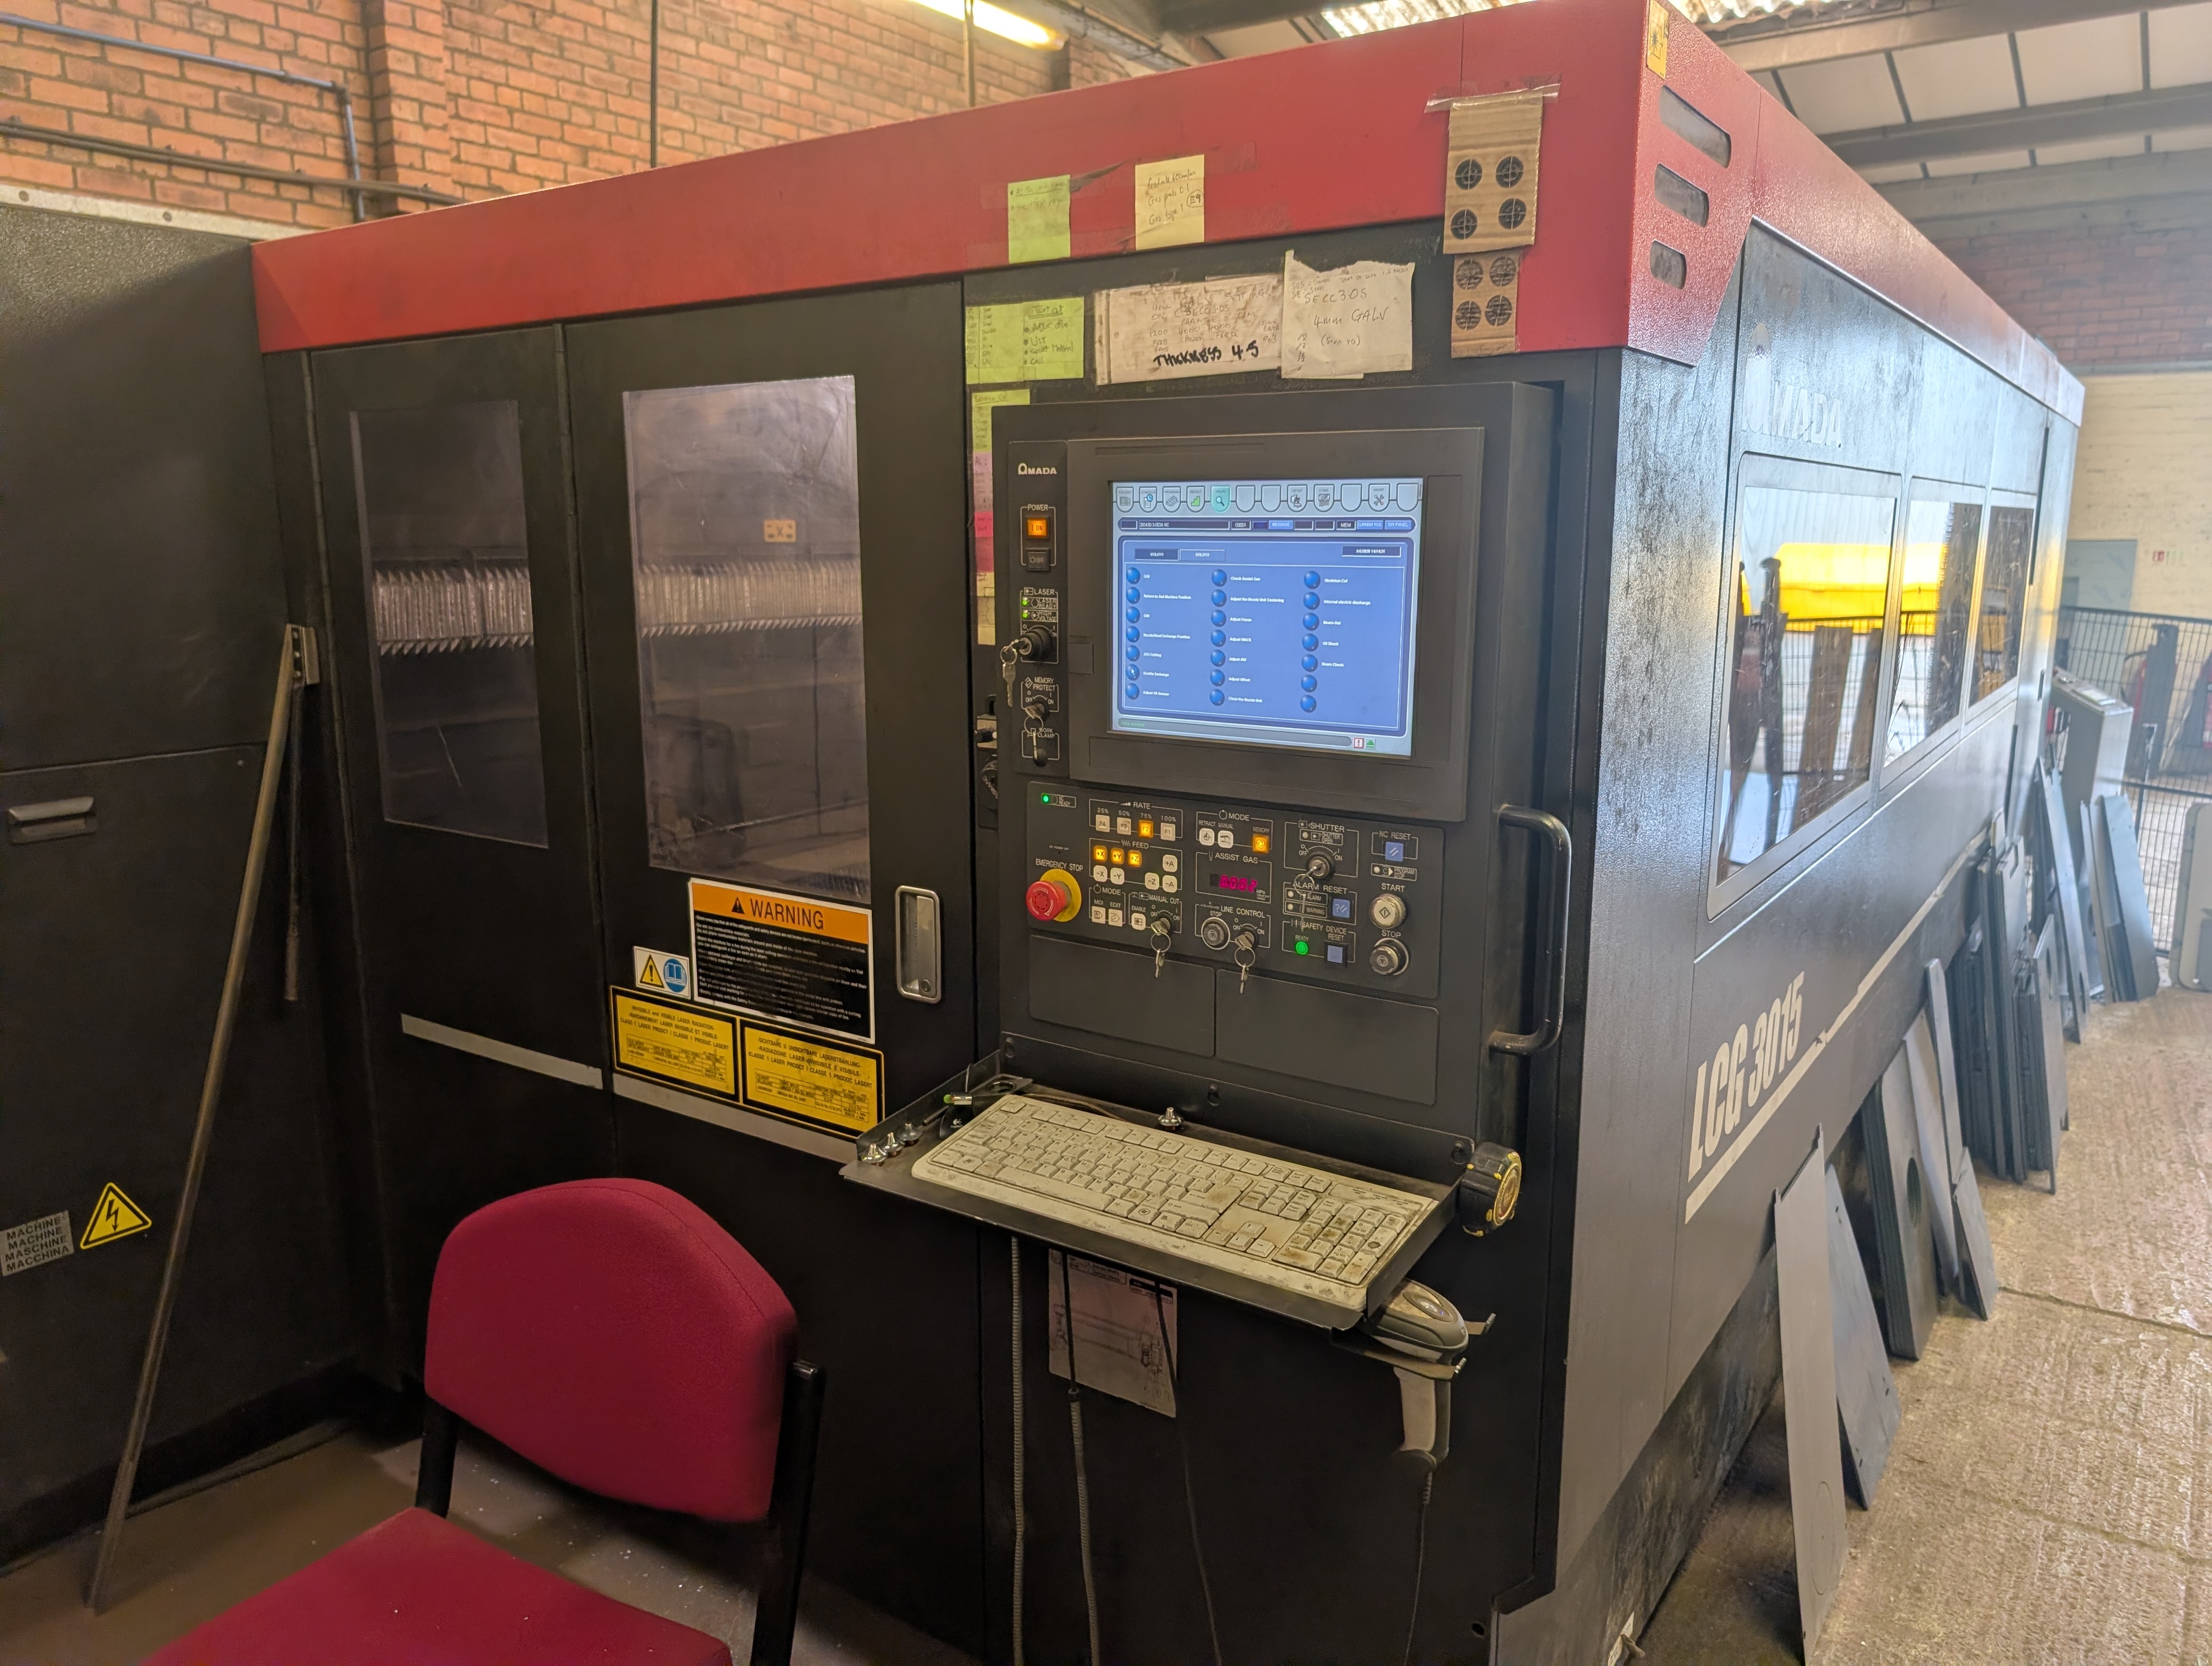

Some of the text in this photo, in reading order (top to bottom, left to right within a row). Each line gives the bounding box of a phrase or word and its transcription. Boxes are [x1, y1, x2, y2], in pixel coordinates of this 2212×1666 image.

[1133, 802, 1150, 810] RATE
[1229, 813, 1250, 821] MODE
[1310, 822, 1345, 833] SHUTTER
[1391, 832, 1411, 841] RESET
[1132, 841, 1149, 849] FEED
[1215, 853, 1240, 861] ASSIST
[1036, 858, 1083, 872] EMERGENCY STOP
[1102, 887, 1121, 895] MODE
[1293, 881, 1348, 894] ALARM RESET
[1381, 883, 1405, 892] START
[1149, 895, 1168, 904] MANUAL
[750, 898, 824, 930] WARNING
[1237, 908, 1265, 918] CONTROL
[1307, 907, 1325, 915] WARNING
[1302, 921, 1347, 935] SAFETY DEVICE
[1381, 929, 1401, 938] STOP
[673, 1032, 688, 1040] CLASSE
[749, 1051, 764, 1060] KLASSE
[771, 1057, 785, 1065] LASER
[810, 1067, 827, 1077] CLASSE
[855, 1078, 872, 1088] LASERT
[1688, 971, 1805, 1183] LCG 3015
[7, 1218, 60, 1240] MACHINE
[8, 1226, 62, 1251] MACHINE
[5, 1235, 66, 1261] MASCHINE
[7, 1245, 69, 1272] MACCHINA
